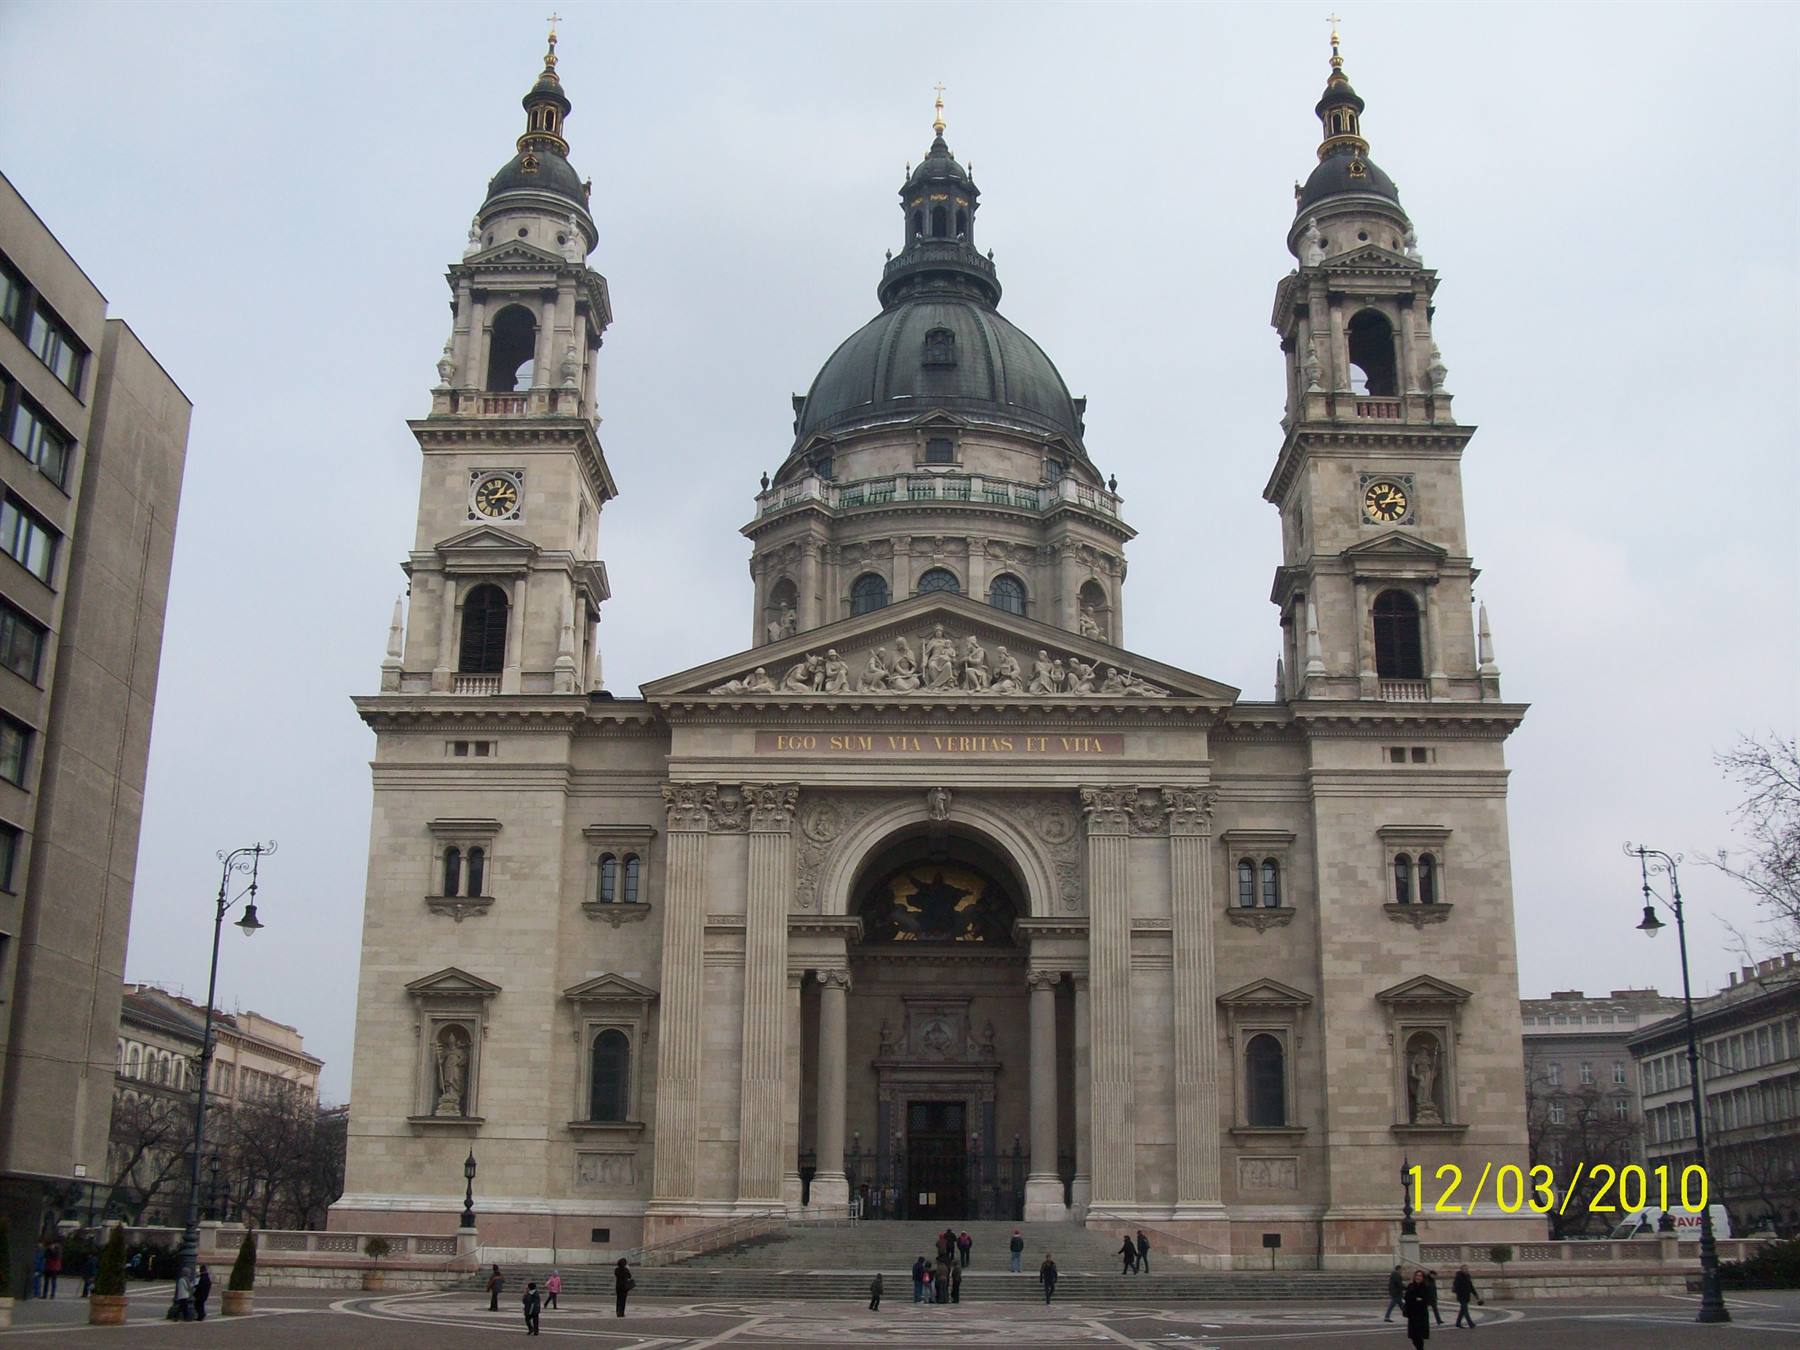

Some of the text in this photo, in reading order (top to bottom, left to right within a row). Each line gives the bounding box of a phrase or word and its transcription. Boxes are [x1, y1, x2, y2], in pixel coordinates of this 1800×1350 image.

[776, 735, 1103, 753] EGO SUM VIA VERITAS ET VITA
